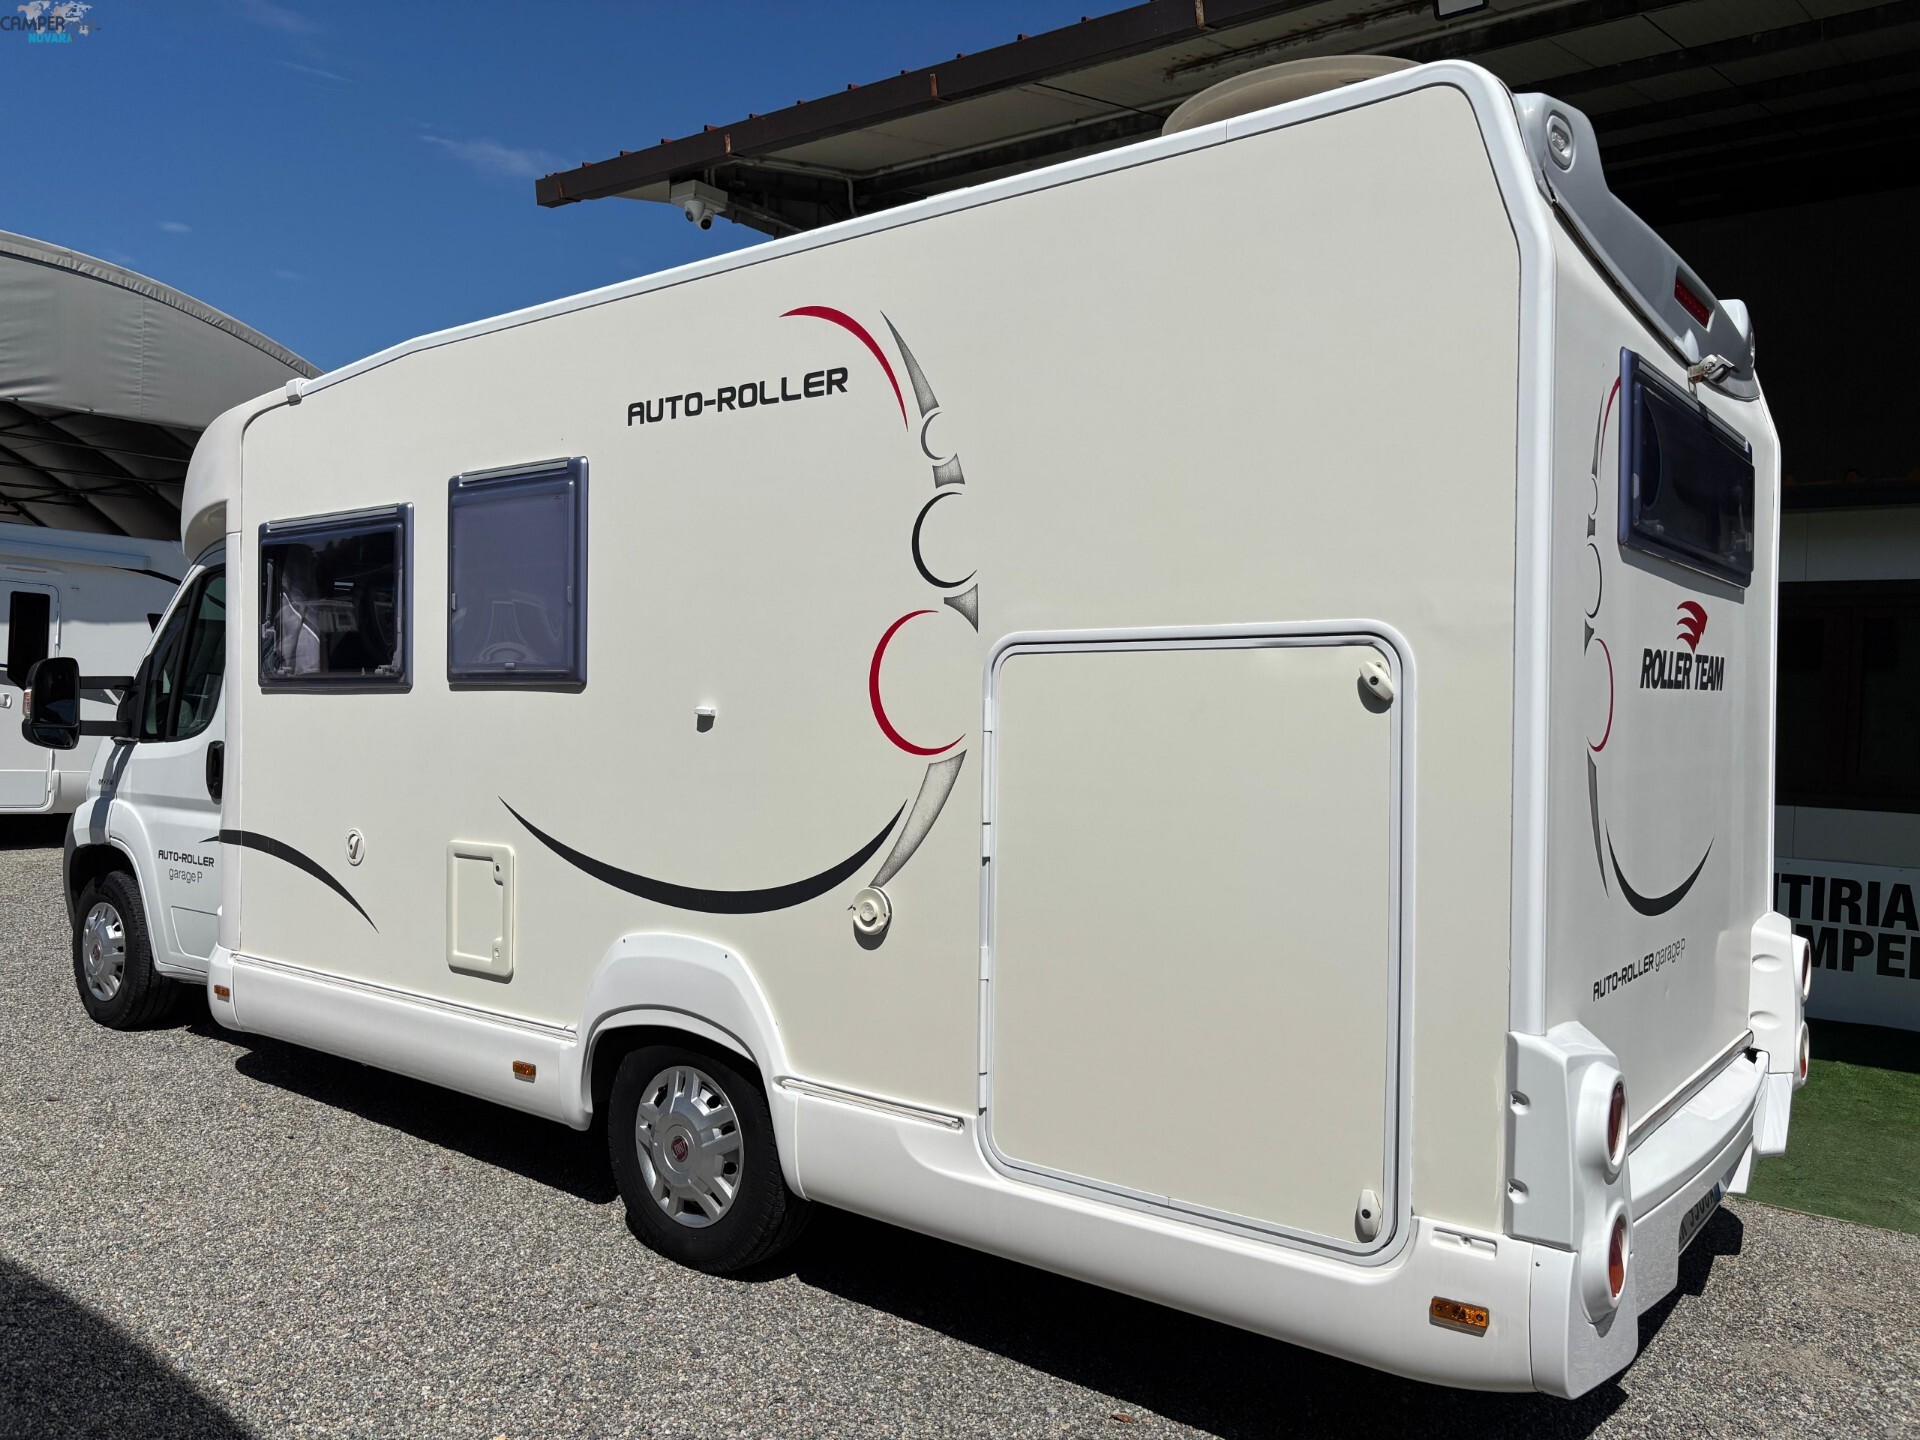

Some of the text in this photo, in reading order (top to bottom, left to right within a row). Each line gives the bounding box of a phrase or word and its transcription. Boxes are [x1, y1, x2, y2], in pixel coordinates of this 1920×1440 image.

[627, 366, 848, 427] AUTO-ROLLER
[1640, 648, 1725, 691] ROLLER TEAM
[158, 849, 215, 868] AUTO-ROLLER
[1593, 952, 1655, 1002] AUTO-ROLLER
